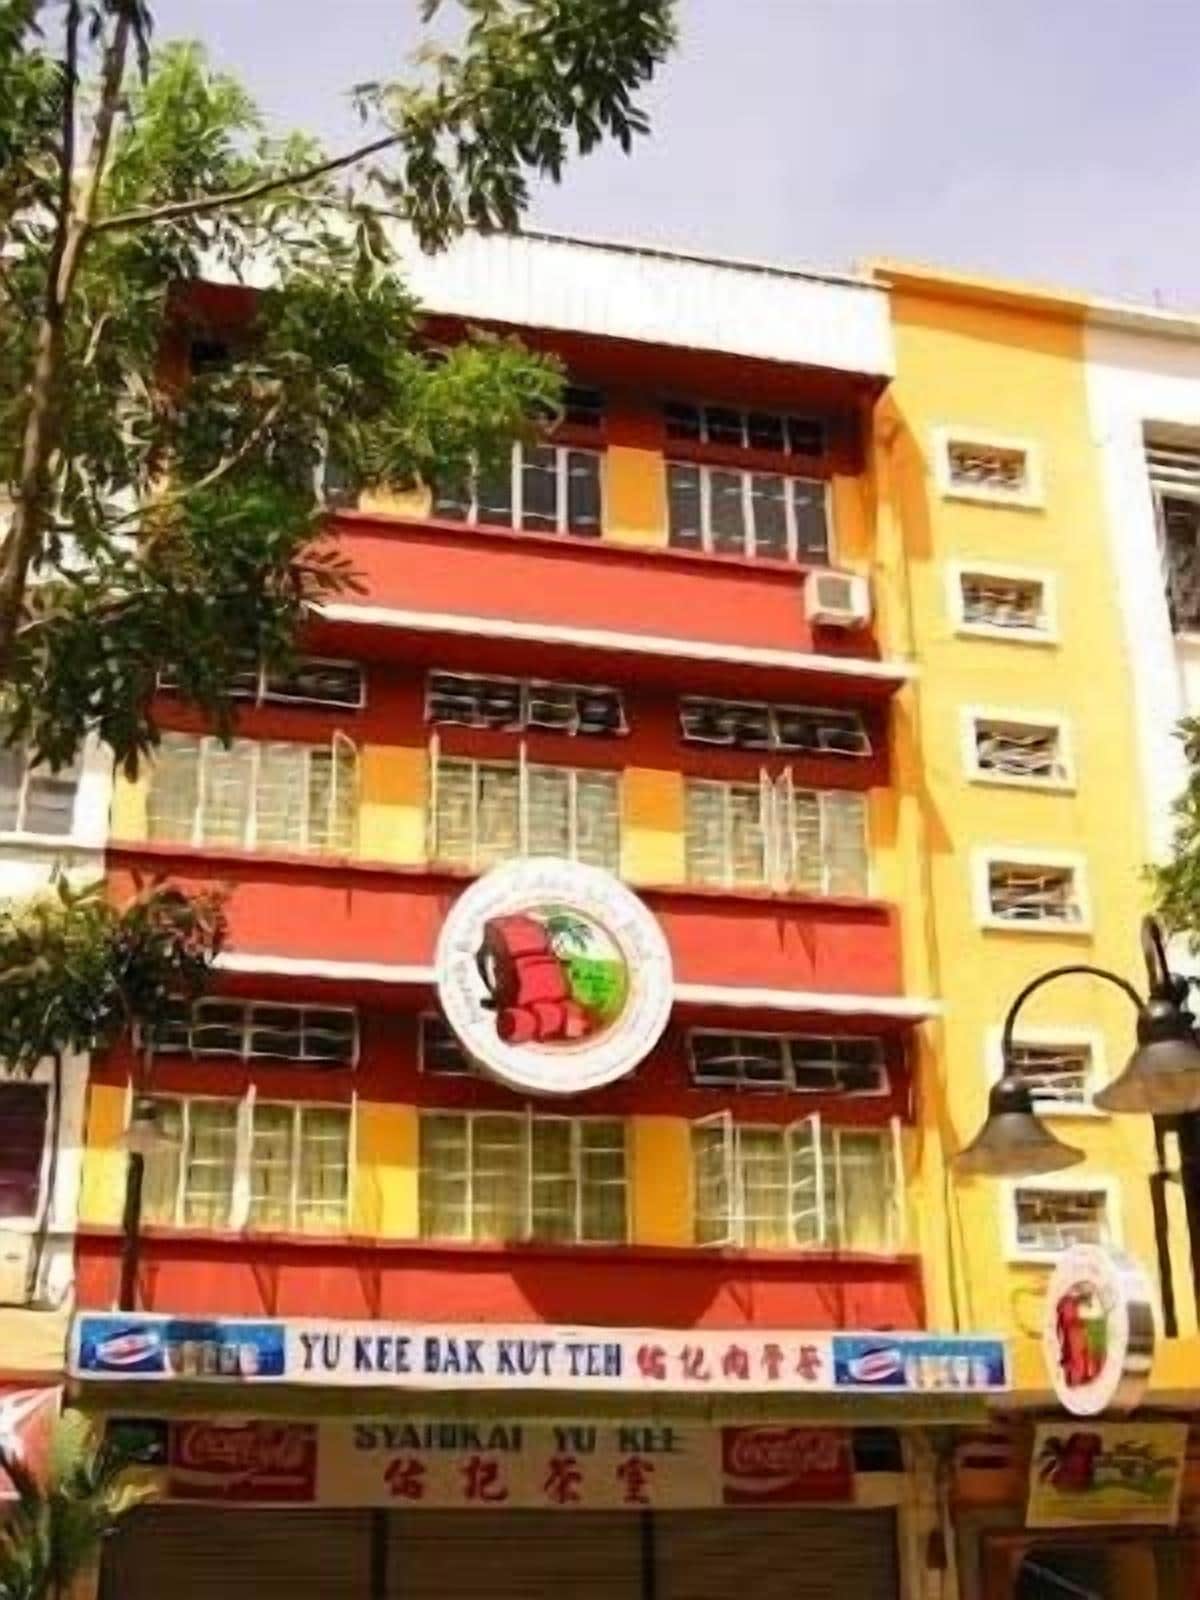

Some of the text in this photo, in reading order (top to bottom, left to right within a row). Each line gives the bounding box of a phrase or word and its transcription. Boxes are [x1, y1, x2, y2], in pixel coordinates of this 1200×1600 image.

[299, 1332, 623, 1377] YU KEE BAK KUT TEH
